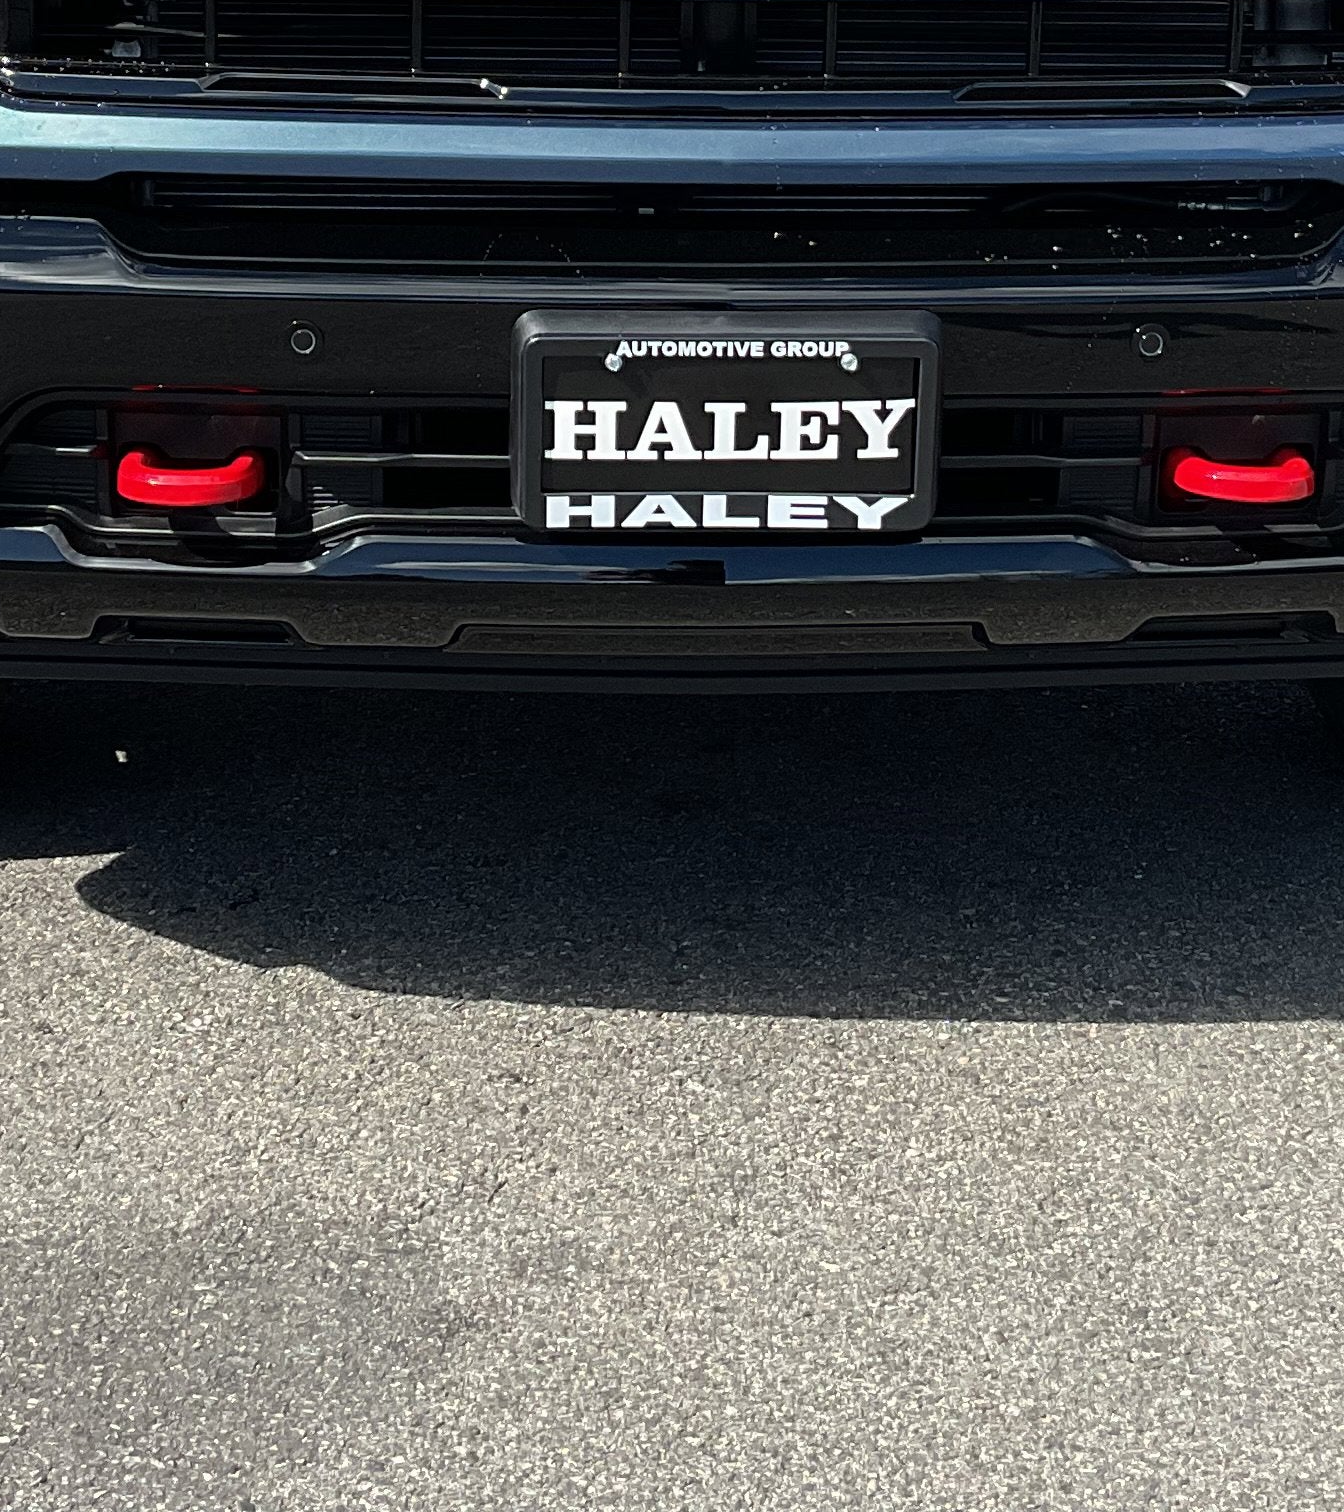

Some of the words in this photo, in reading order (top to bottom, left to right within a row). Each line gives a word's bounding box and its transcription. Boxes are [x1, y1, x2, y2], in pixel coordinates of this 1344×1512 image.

[616, 340, 764, 358] AUTOMOTIVE
[770, 340, 850, 358] GROUP
[544, 398, 916, 461] HALEY
[545, 494, 910, 530] HALEY
